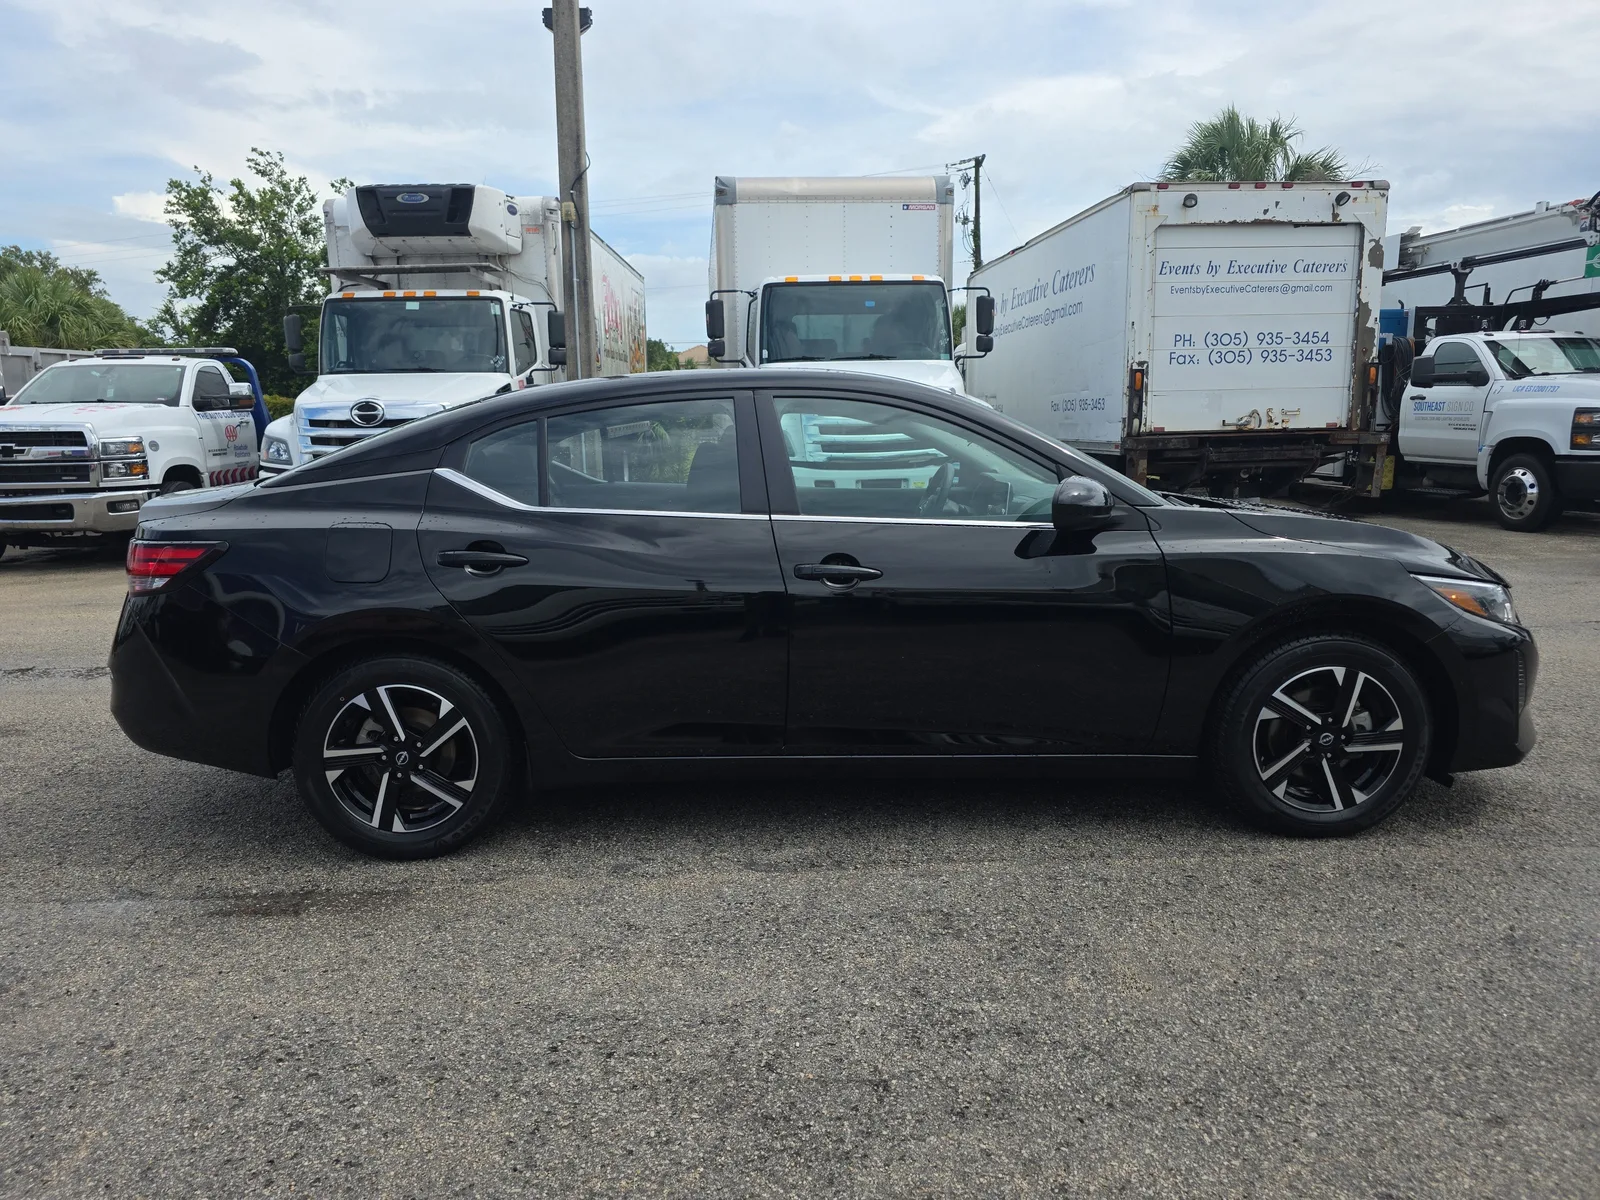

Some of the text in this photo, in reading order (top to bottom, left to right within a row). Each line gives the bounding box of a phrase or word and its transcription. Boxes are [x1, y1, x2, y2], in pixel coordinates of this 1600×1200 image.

[1158, 258, 1348, 277] Events by Executive Caterers
[1001, 292, 1009, 317] by
[1011, 278, 1049, 311] Executive
[1052, 263, 1096, 296] Caterers
[1170, 283, 1333, 295] EventsbyExecutiveCaterers@gmail.com
[1173, 330, 1330, 348] PH: (305) 935-3454
[1169, 348, 1333, 366] Fax: (305) 935-3453
[1078, 398, 1106, 412] 935-3453
[1413, 401, 1446, 412] SOUTHEAST
[1447, 401, 1463, 412] SIGN
